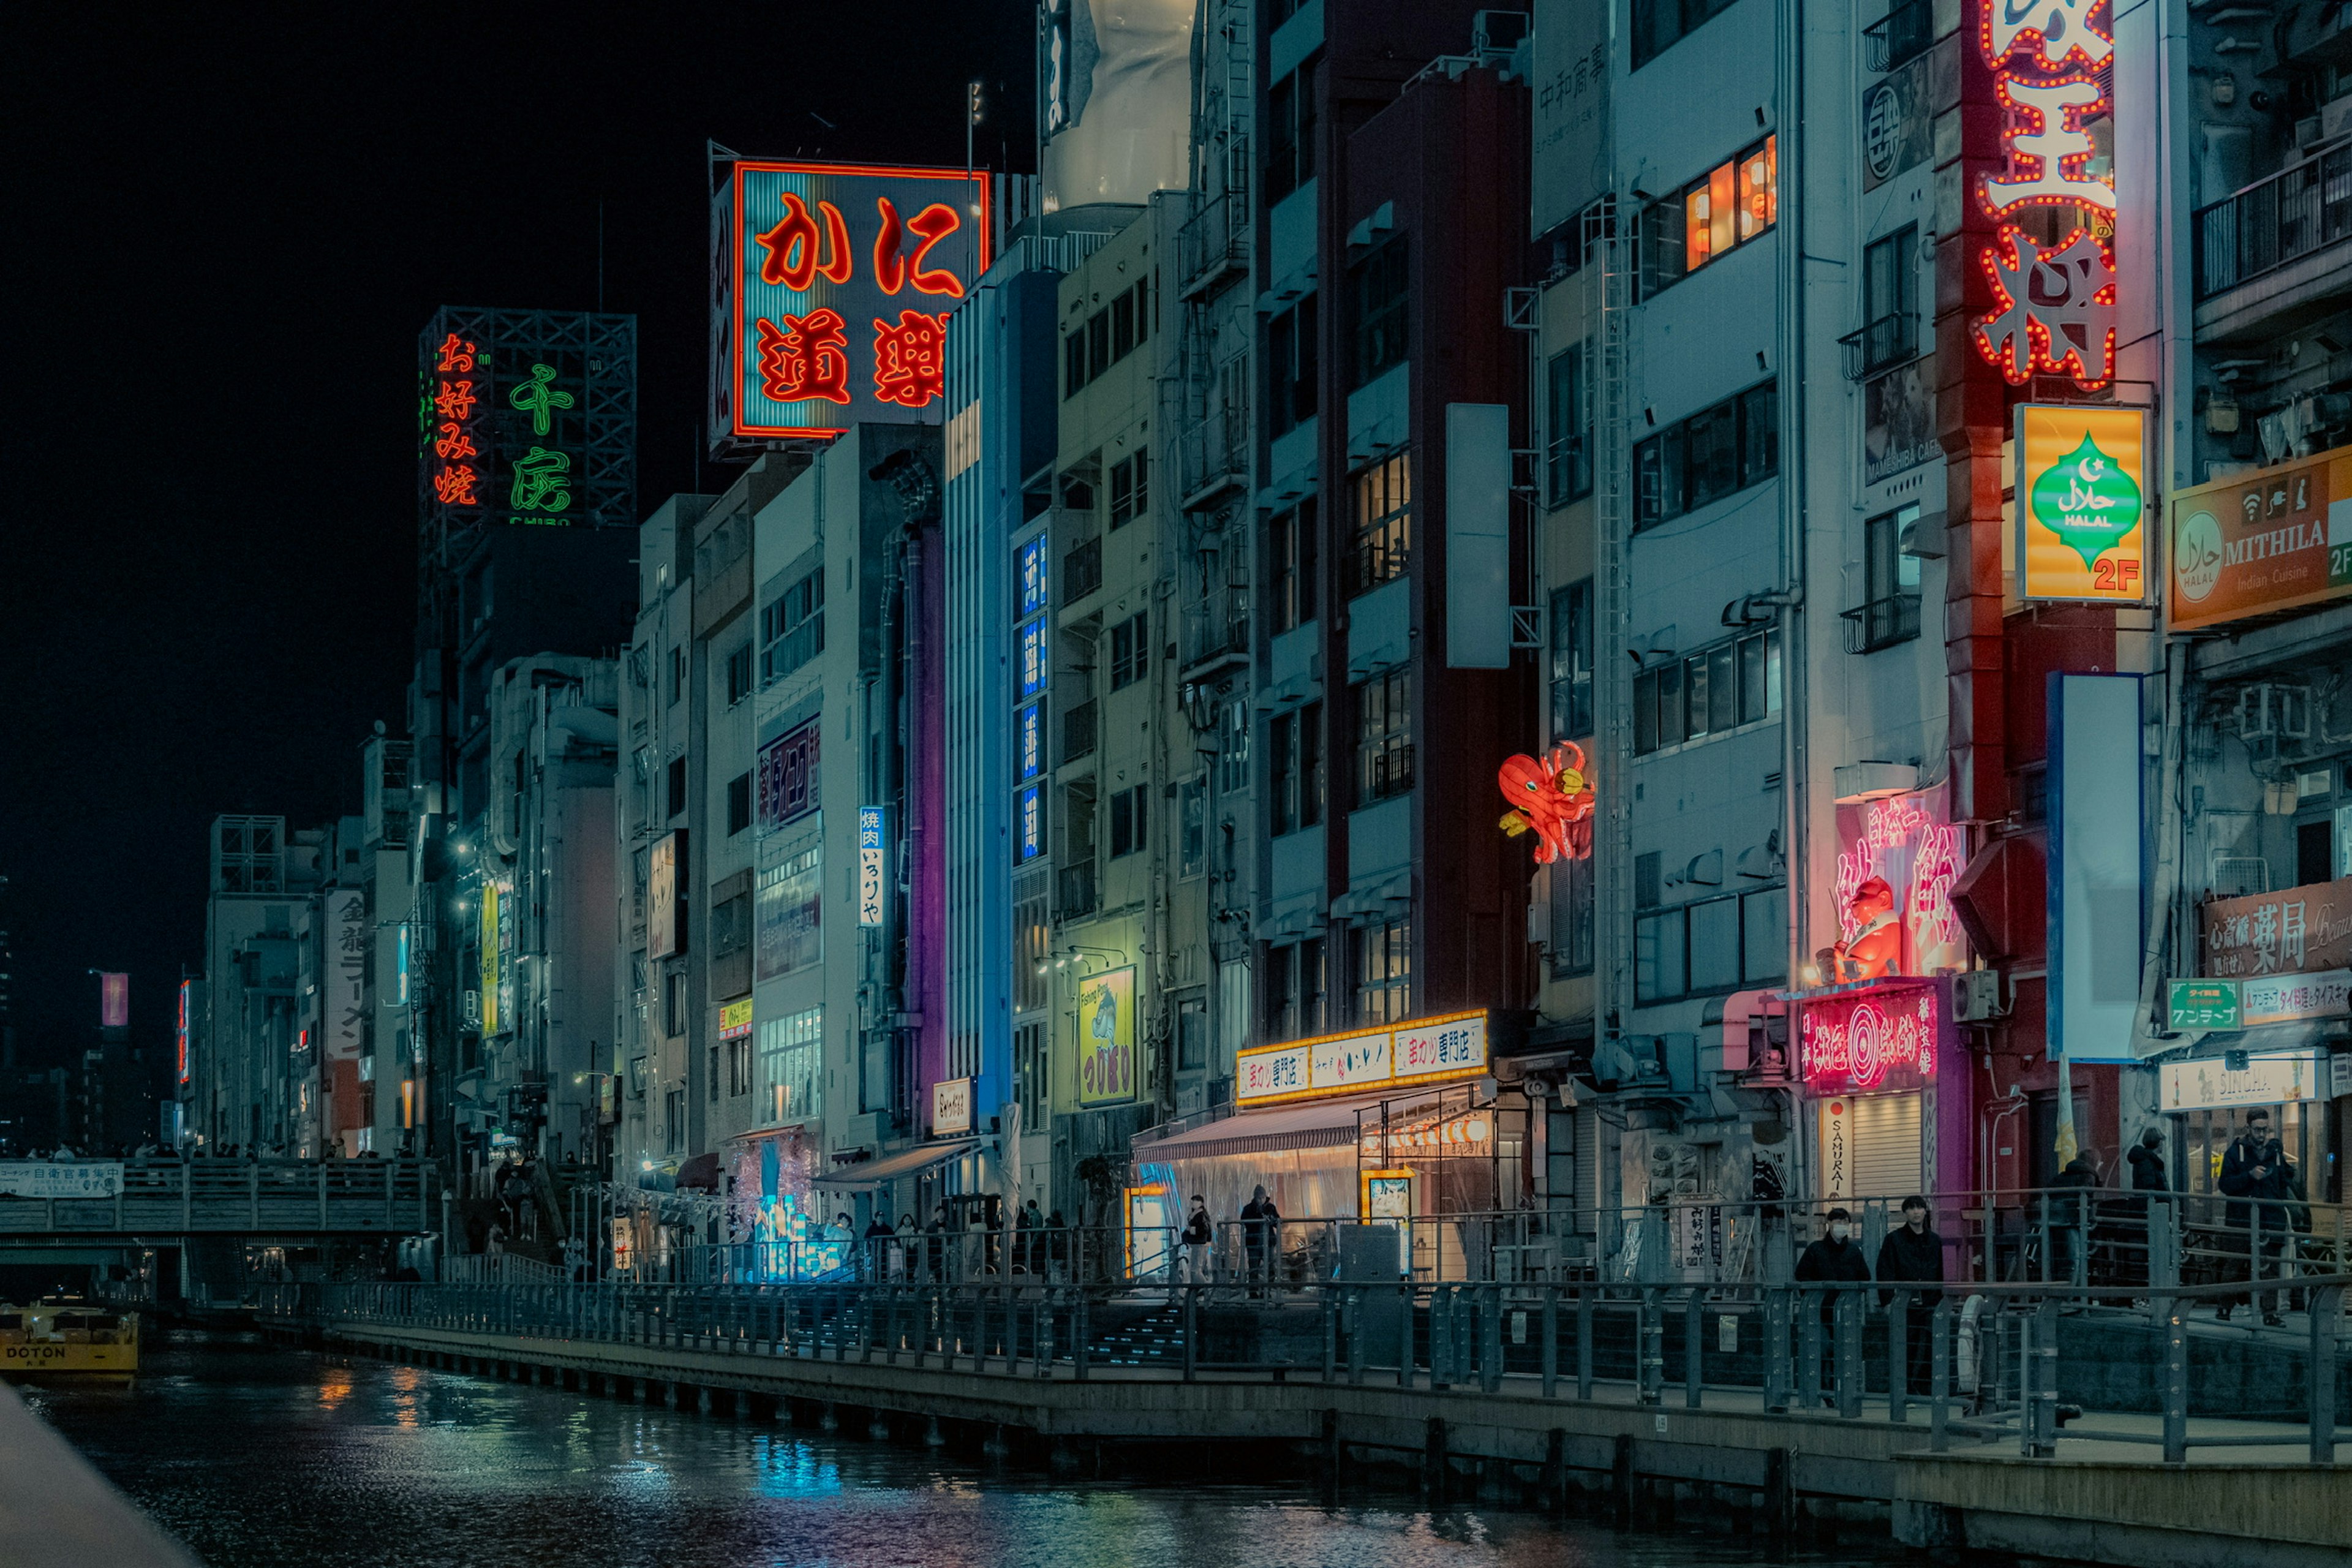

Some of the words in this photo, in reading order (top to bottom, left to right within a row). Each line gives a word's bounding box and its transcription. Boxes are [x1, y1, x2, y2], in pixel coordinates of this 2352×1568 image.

[755, 192, 966, 299] かに
[510, 363, 575, 513] 千房
[2057, 477, 2116, 513] حلال
[2064, 514, 2113, 528] HALAL
[2225, 519, 2325, 567] MITHILA
[2093, 557, 2139, 592] 2F
[2184, 573, 2214, 588] HALAL
[2237, 575, 2268, 593] Indian
[2272, 565, 2308, 582] Cuisine
[862, 812, 880, 846] 焼肉
[862, 851, 879, 924] いろりや
[2209, 913, 2250, 951] 心斎橋
[2252, 898, 2307, 974] 薬局
[1409, 1029, 1469, 1066] 串カツ専門店
[1084, 1044, 1130, 1096] つりぼり
[1250, 1057, 1297, 1088] 串カツ専門店
[34, 1167, 119, 1180] 自衛官募集中
[1831, 1120, 1844, 1191] SAMURAI
[6, 1346, 66, 1358] DOTON
